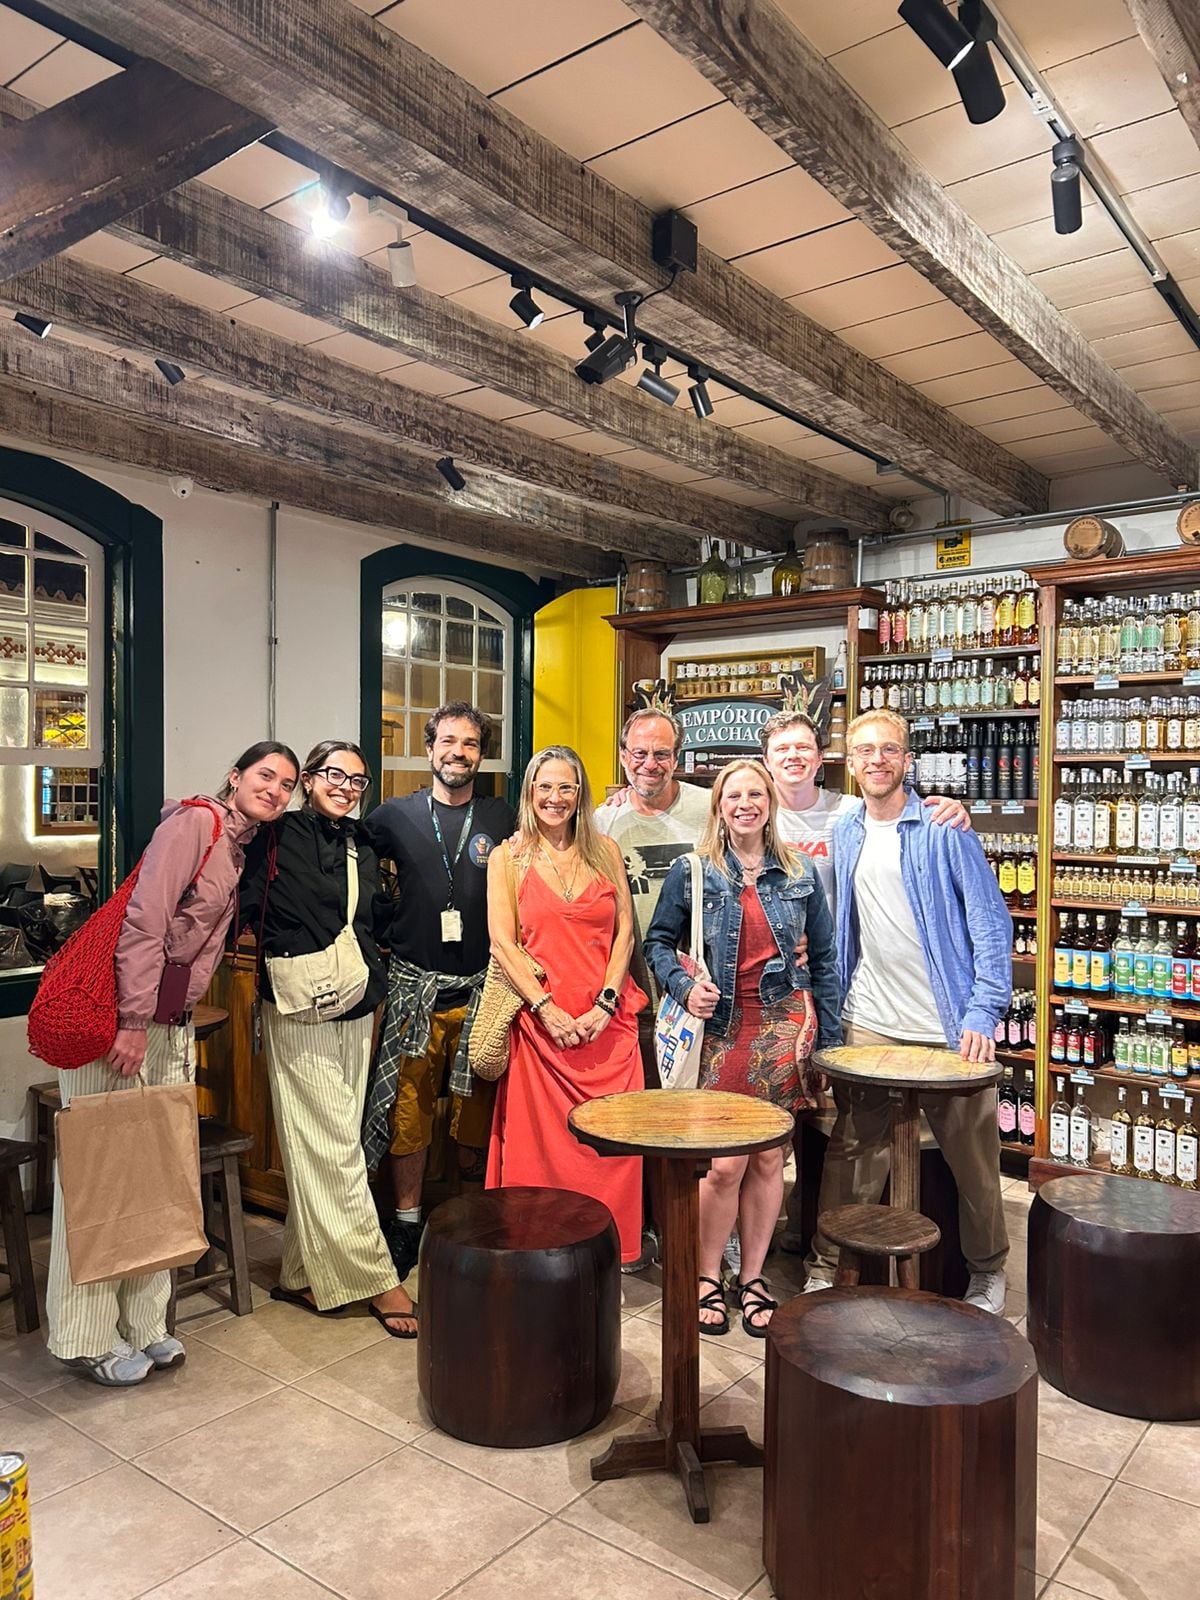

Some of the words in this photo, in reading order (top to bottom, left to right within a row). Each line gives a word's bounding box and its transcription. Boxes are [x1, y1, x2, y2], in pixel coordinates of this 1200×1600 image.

[681, 705, 770, 728] EMPÓRIO
[682, 733, 693, 745] A
[695, 726, 764, 745] CACHAÇ
[785, 840, 828, 858] KA
